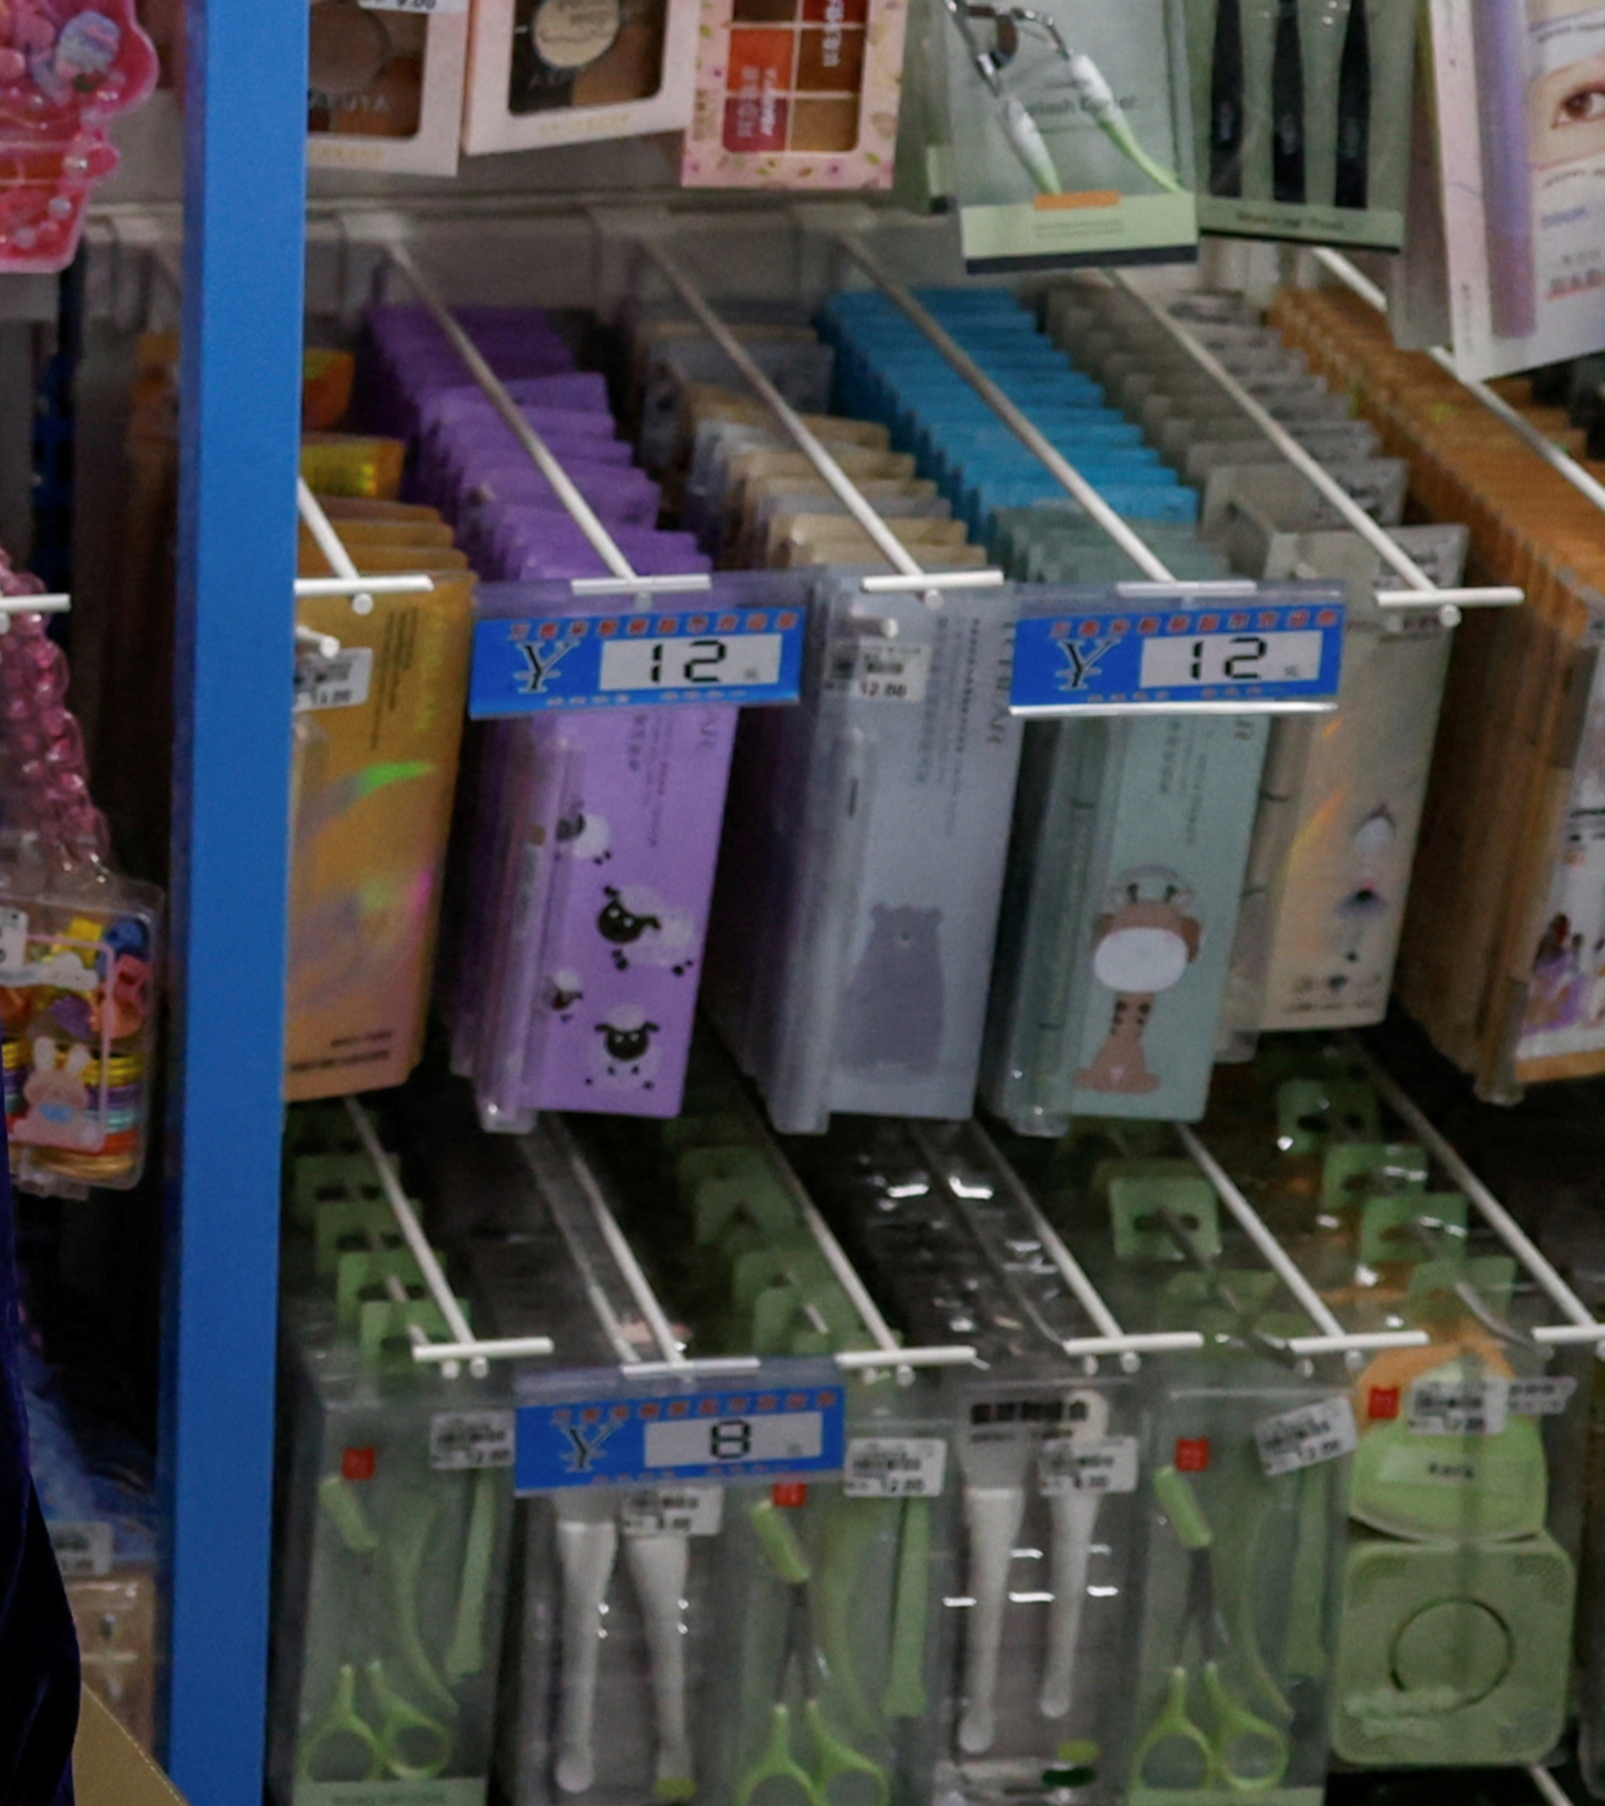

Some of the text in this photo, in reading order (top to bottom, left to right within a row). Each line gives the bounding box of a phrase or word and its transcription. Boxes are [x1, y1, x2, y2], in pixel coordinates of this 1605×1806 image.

[650, 640, 727, 684] 12
[1190, 636, 1268, 681] 12
[710, 1420, 752, 1459] 8
